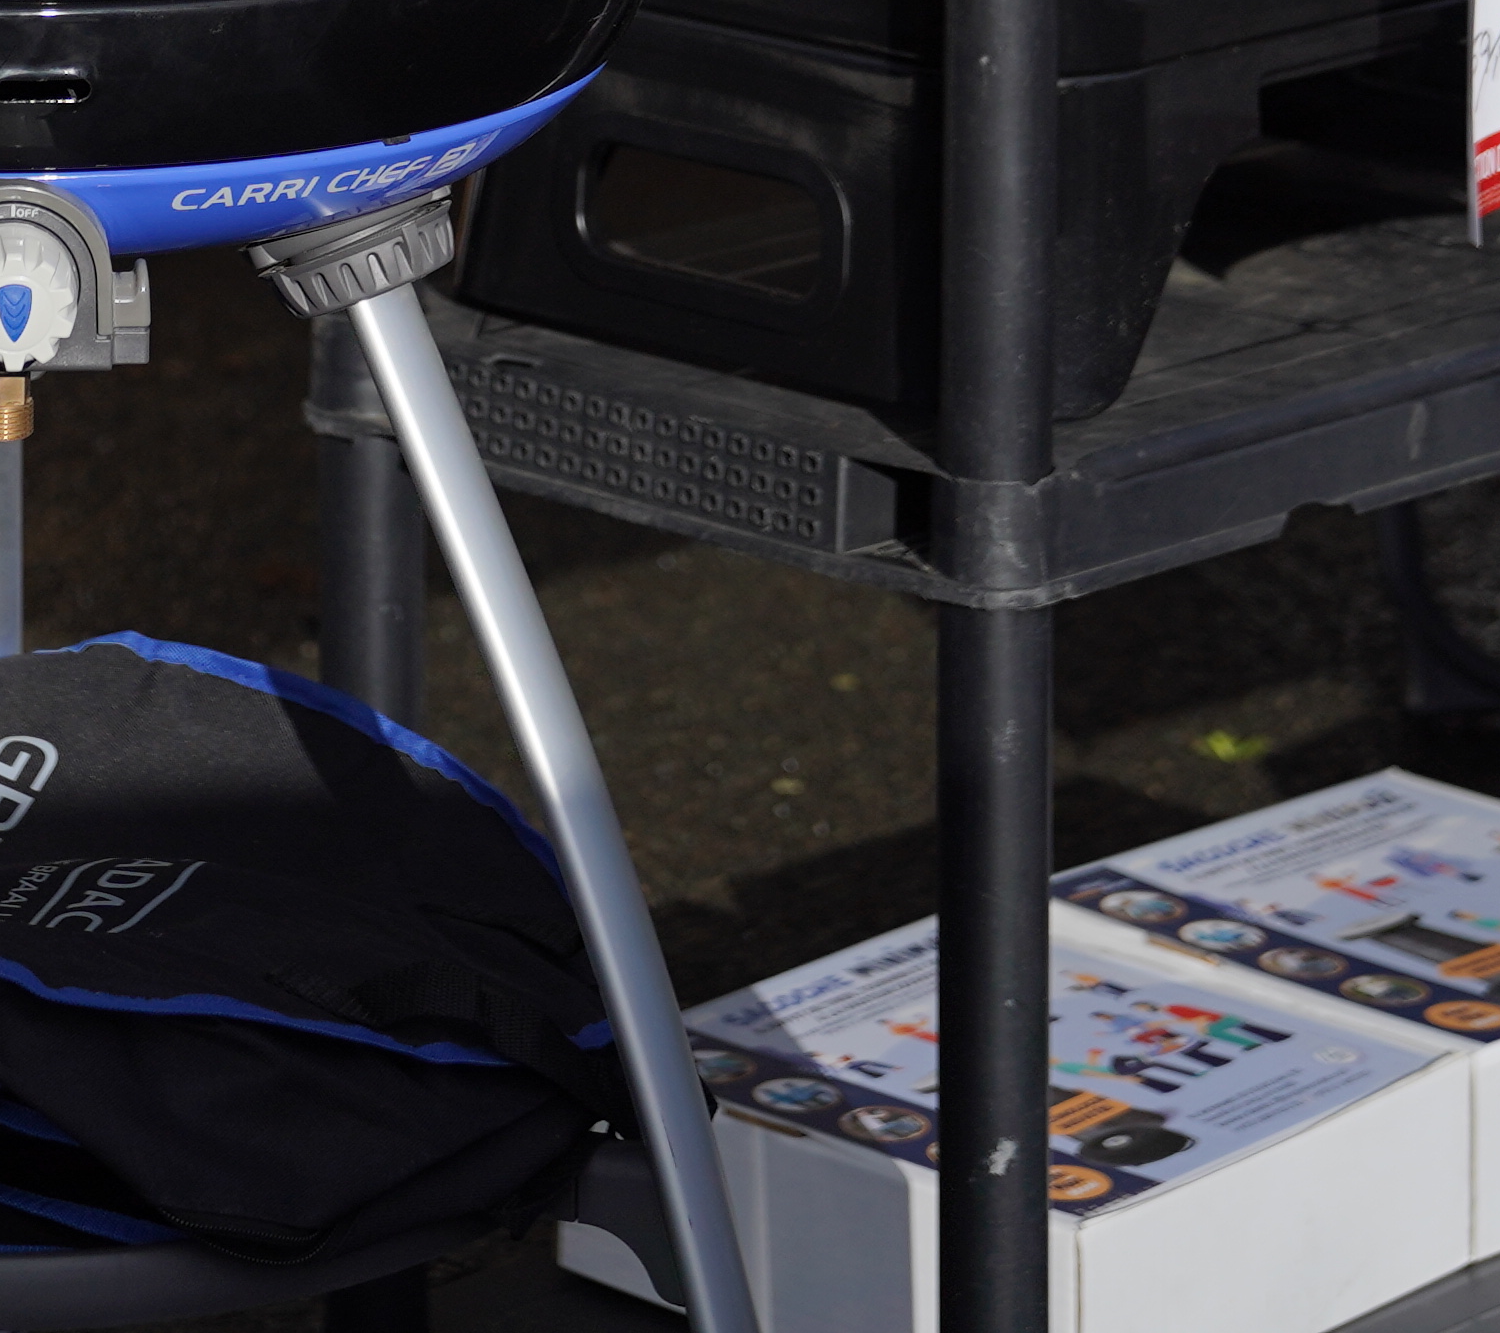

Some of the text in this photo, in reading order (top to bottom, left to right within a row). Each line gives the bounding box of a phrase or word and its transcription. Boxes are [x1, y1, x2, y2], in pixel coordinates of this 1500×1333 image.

[161, 176, 321, 211] CARRI
[326, 154, 434, 194] CHEF
[15, 207, 39, 218] OFF
